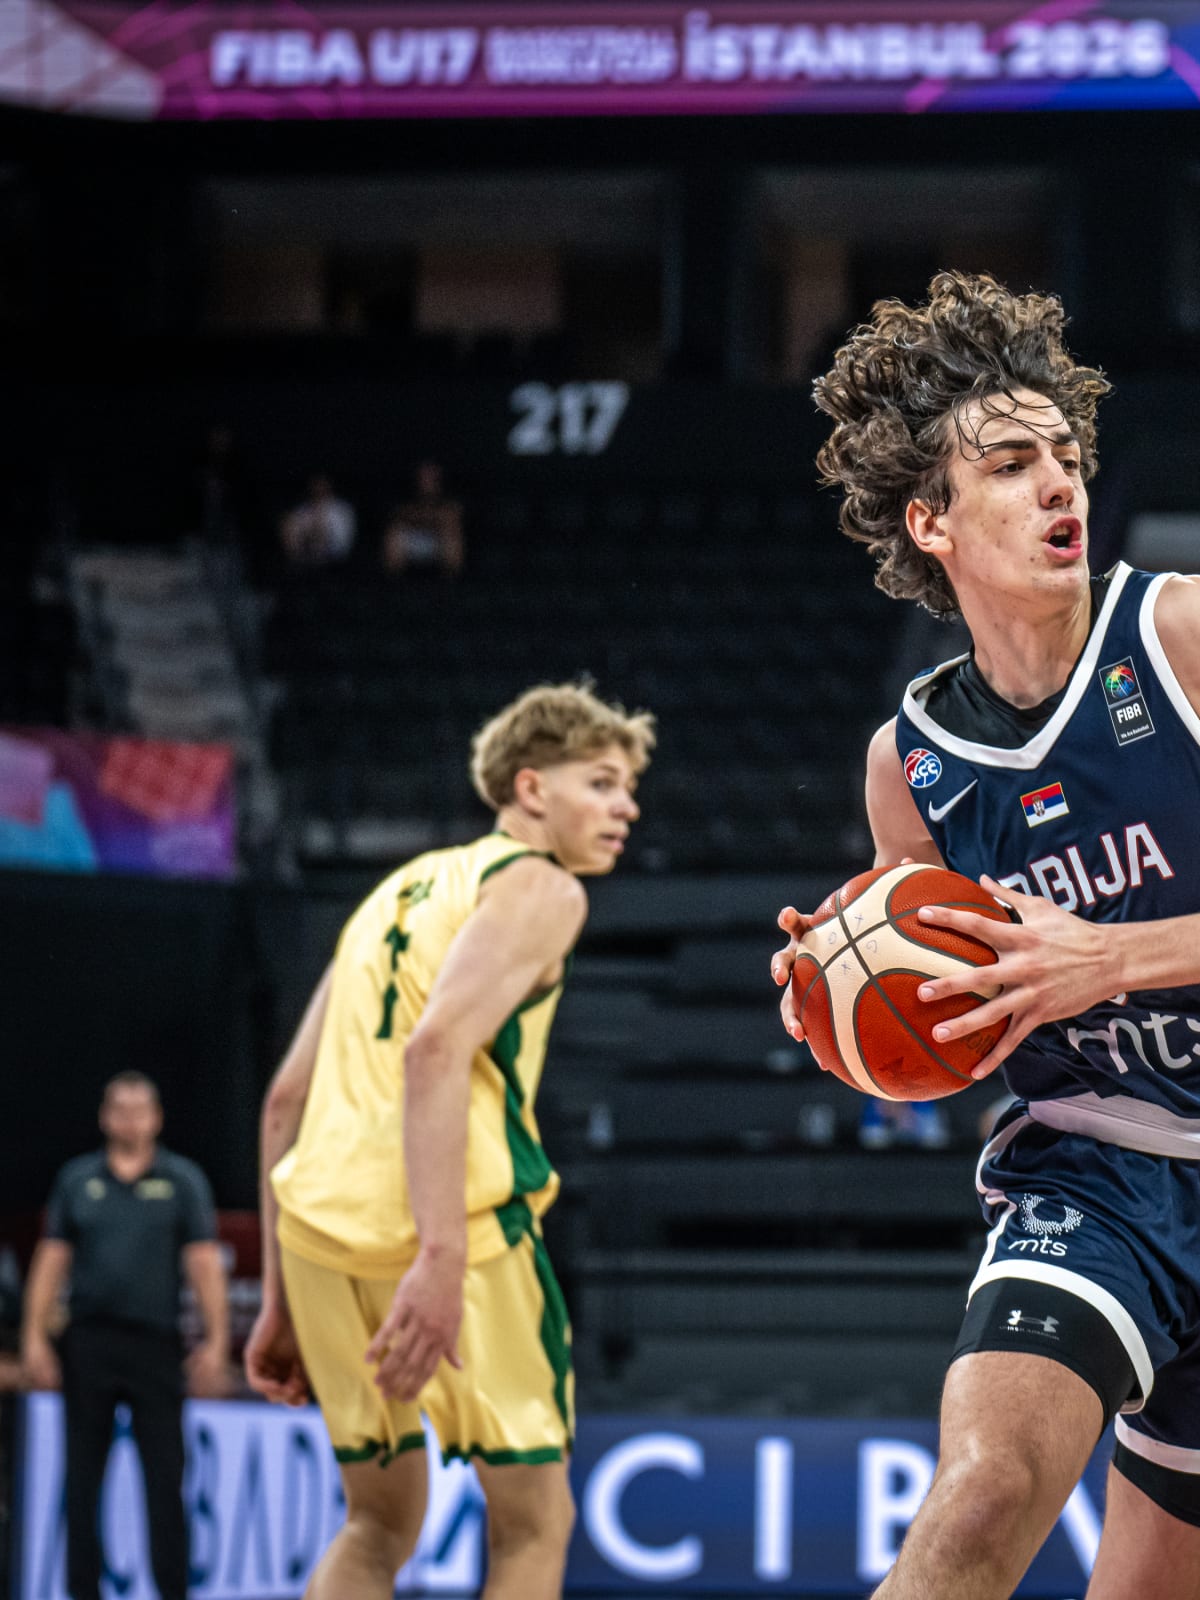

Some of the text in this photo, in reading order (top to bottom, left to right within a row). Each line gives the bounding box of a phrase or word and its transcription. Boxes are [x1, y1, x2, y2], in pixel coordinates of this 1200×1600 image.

[211, 28, 362, 87] FIBA
[369, 27, 480, 86] U17
[1007, 18, 1170, 79] 2026
[508, 380, 628, 455] 217
[1116, 703, 1142, 724] FIBA
[1007, 1230, 1068, 1257] mts
